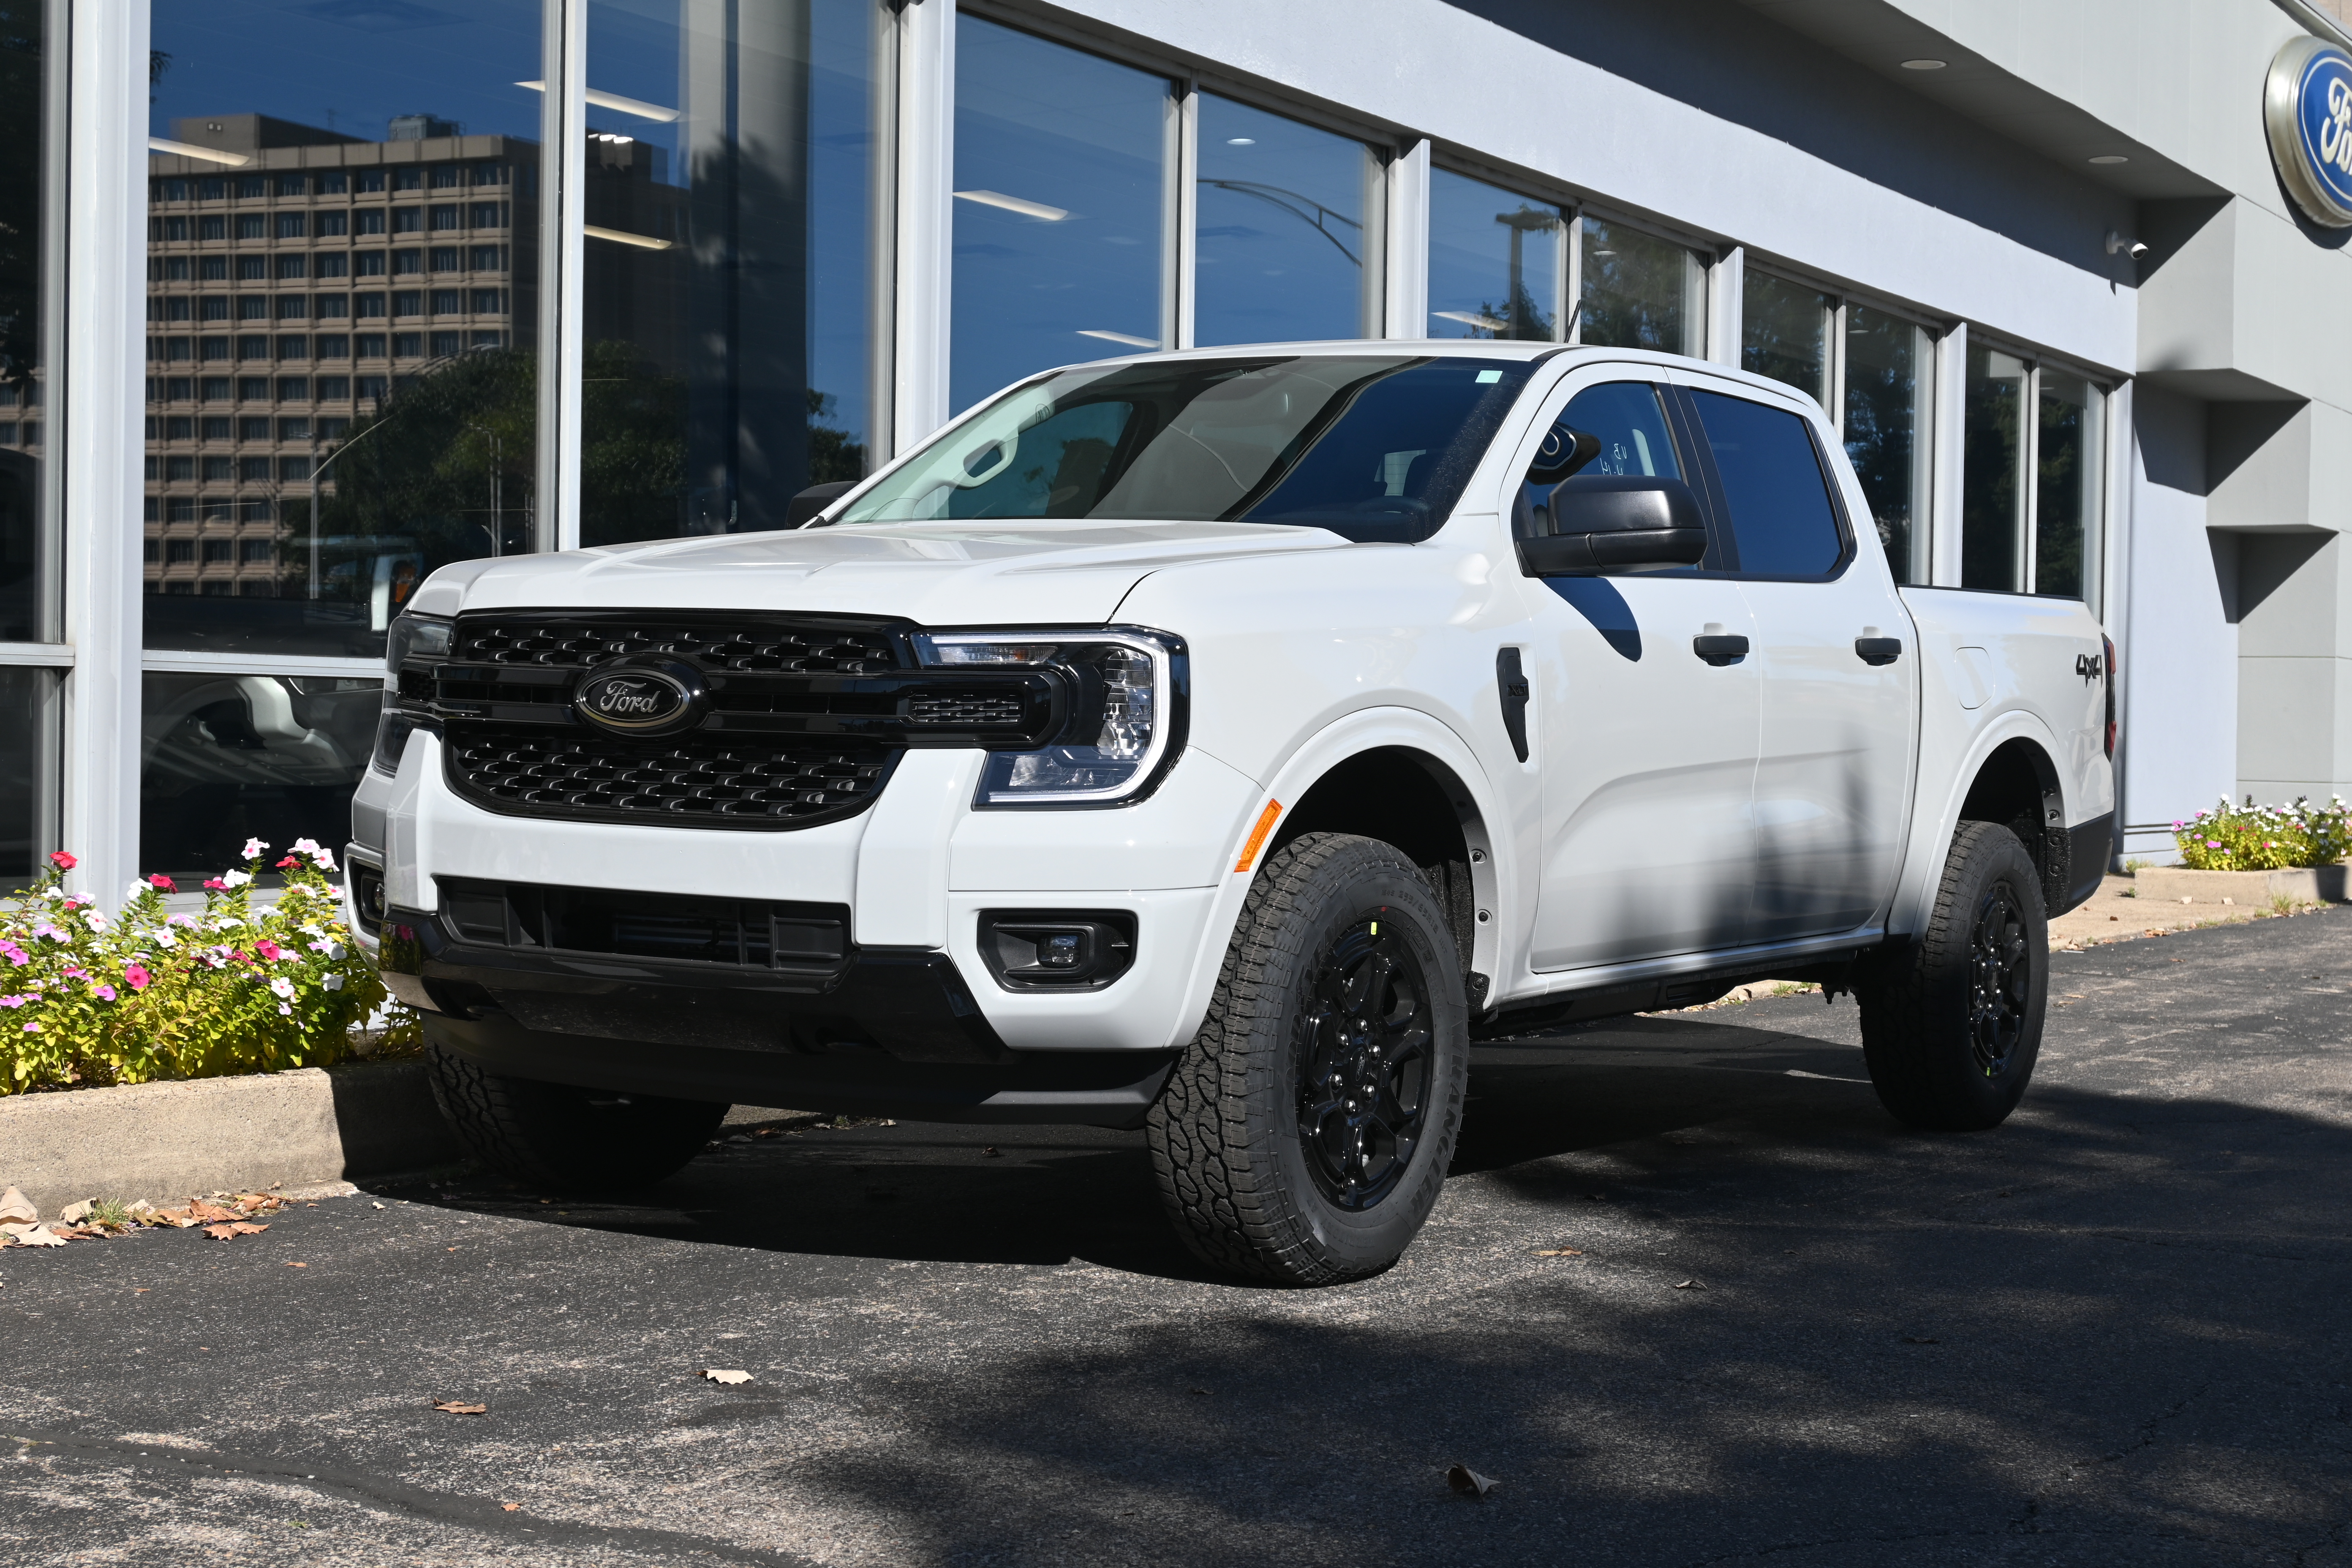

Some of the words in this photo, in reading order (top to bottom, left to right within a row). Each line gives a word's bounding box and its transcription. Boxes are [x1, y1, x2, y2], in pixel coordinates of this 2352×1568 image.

[2321, 77, 2352, 175] Fo
[600, 681, 660, 713] Ford
[1410, 1020, 1464, 1213] WRANGLER
